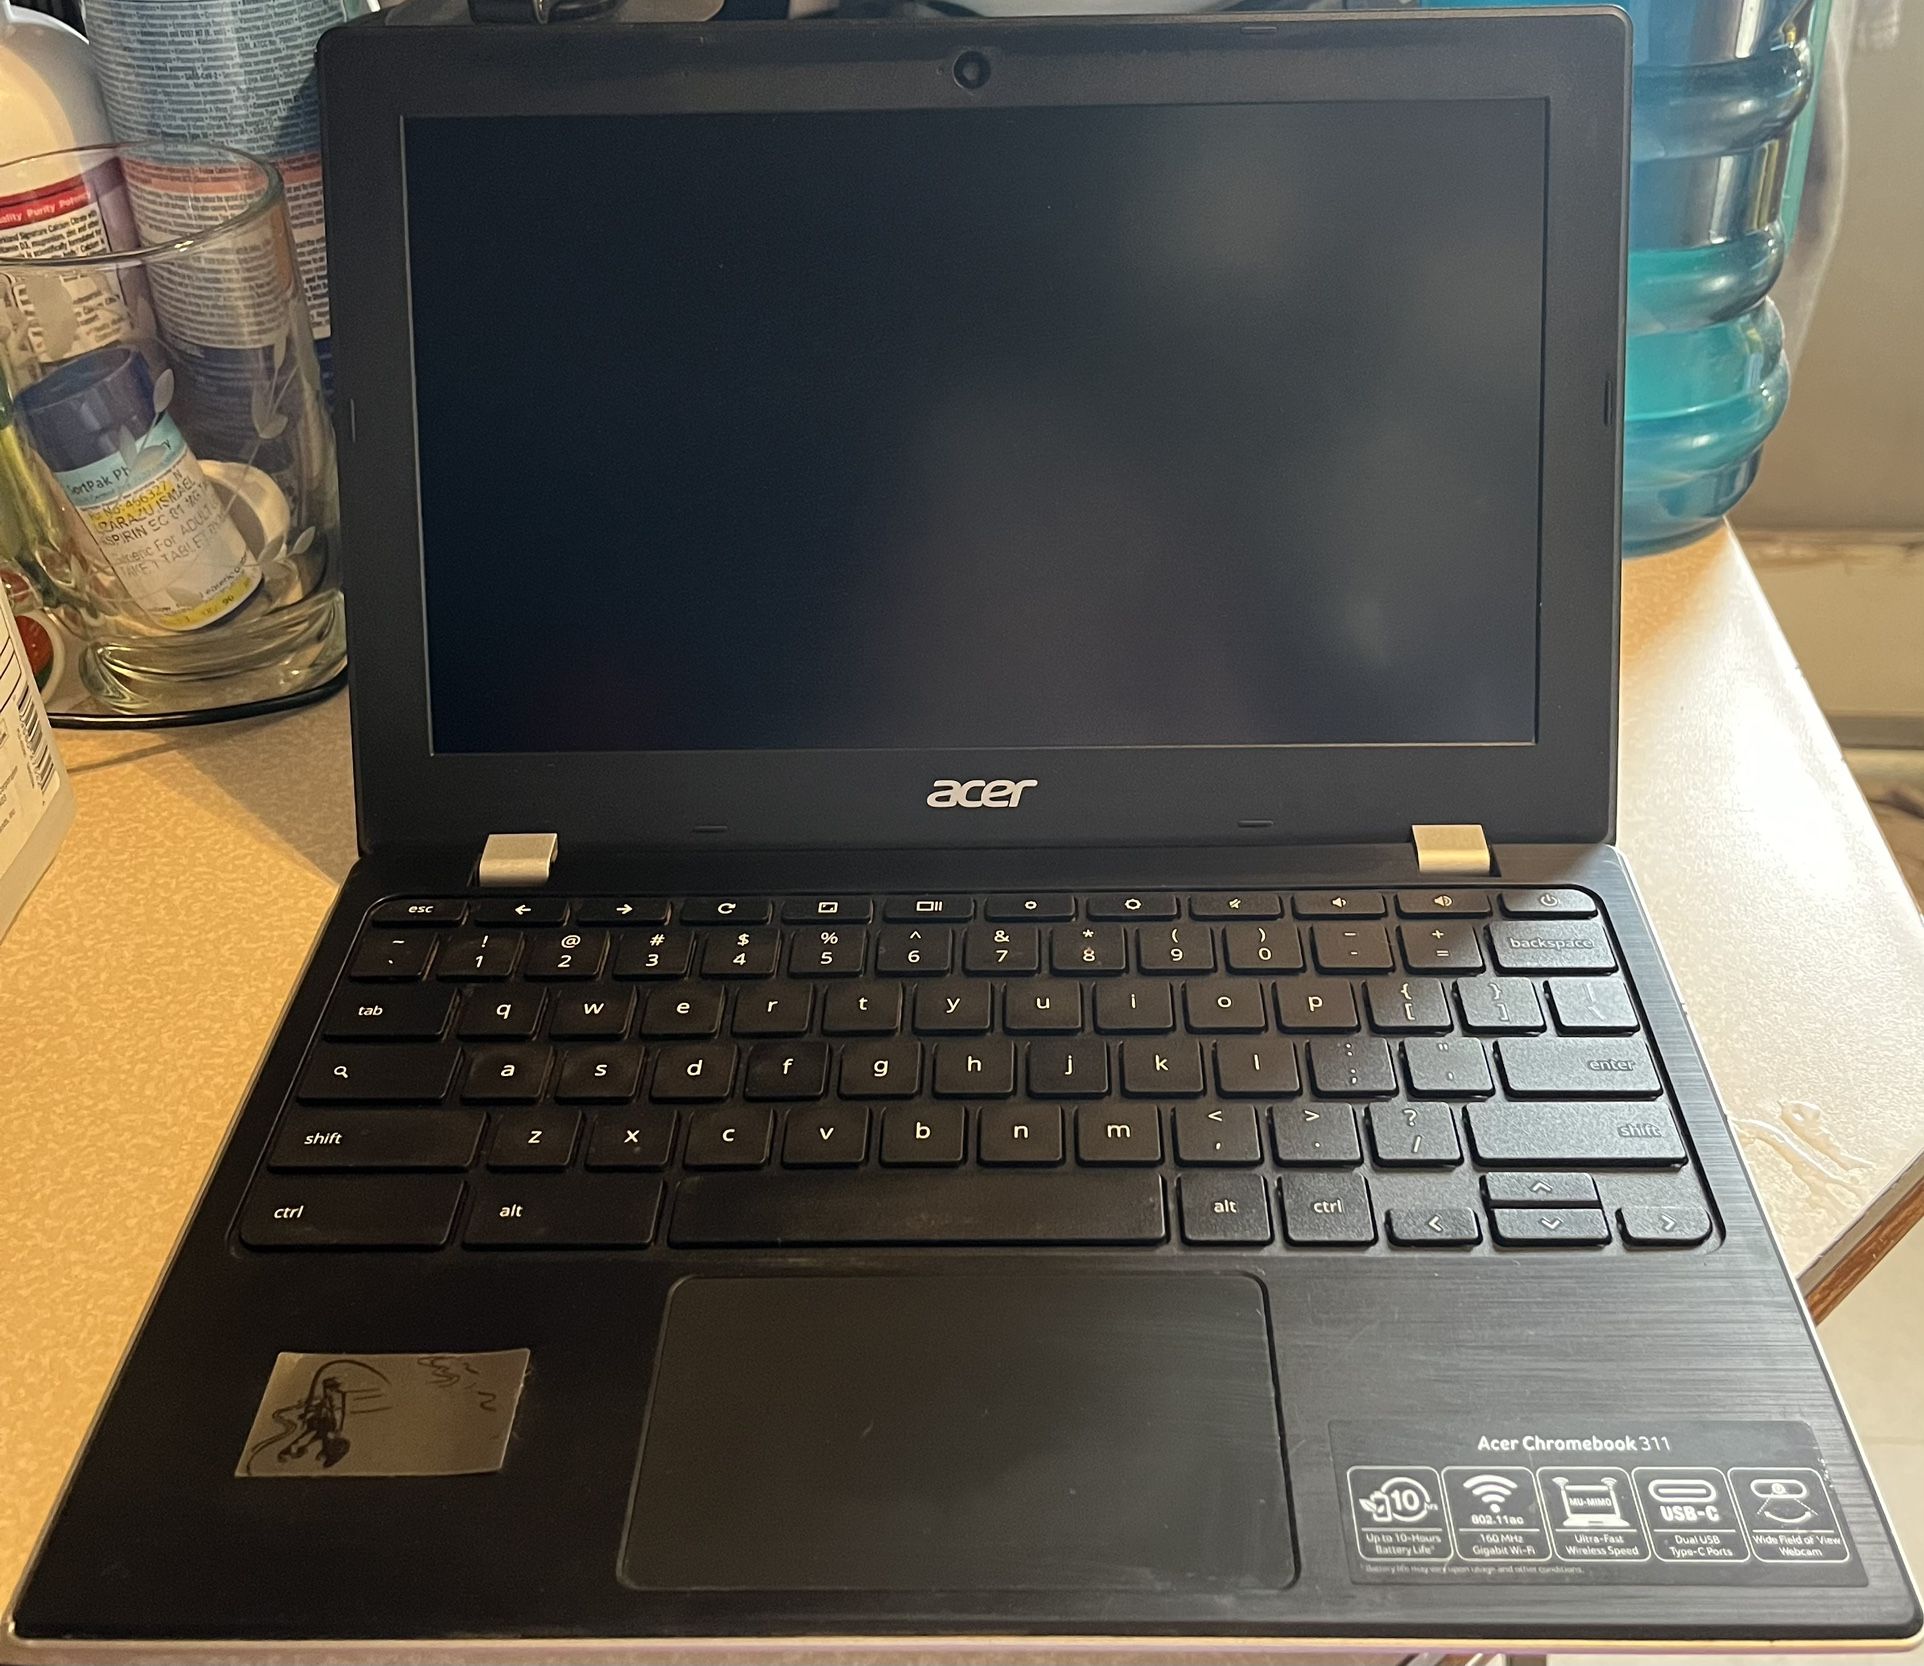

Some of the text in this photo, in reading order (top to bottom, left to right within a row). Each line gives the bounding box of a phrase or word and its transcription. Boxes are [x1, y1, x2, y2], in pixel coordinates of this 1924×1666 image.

[26, 204, 56, 217] Purity
[926, 779, 1038, 808] acer
[408, 905, 434, 913] esc
[649, 933, 665, 946] #
[737, 933, 750, 947] $
[820, 932, 839, 945] %
[994, 930, 1010, 943] &
[1171, 928, 1179, 943] (
[1258, 927, 1266, 943] )
[1432, 929, 1444, 939] +
[481, 935, 489, 948] !
[561, 934, 581, 949] @
[1510, 937, 1594, 951] backspace
[557, 954, 572, 968] 2
[645, 953, 659, 967] 3
[732, 952, 747, 966] 4
[820, 951, 833, 965] 5
[907, 950, 920, 963] 6
[995, 949, 1009, 963] 7
[1082, 947, 1096, 962] 8
[1170, 948, 1183, 962] 9
[1258, 947, 1272, 961] 0
[475, 955, 484, 968] 1
[1400, 983, 1412, 1000] {
[1490, 983, 1501, 1000] }
[676, 1002, 690, 1014] e
[767, 1000, 779, 1013] r
[859, 997, 868, 1011] t
[946, 998, 961, 1014] y
[1036, 997, 1050, 1009] u
[1131, 993, 1136, 1009] i
[1217, 996, 1232, 1008] o
[1308, 996, 1323, 1012] p
[358, 1005, 383, 1016] tab
[496, 1004, 512, 1020] q
[584, 1002, 605, 1015] w
[1404, 1003, 1416, 1020] [
[1498, 1003, 1510, 1021] ]
[686, 1059, 703, 1076] d
[782, 1058, 794, 1075] f
[873, 1060, 889, 1077] g
[967, 1055, 982, 1072] h
[1064, 1055, 1073, 1075] j
[1155, 1054, 1169, 1071] k
[1254, 1054, 1260, 1071] l
[1589, 1058, 1635, 1071] enter
[500, 1064, 515, 1077] a
[594, 1064, 608, 1077] s
[1208, 1110, 1223, 1122] <
[1304, 1110, 1320, 1122] >
[1404, 1109, 1416, 1126] ?
[528, 1130, 543, 1144] z
[624, 1129, 640, 1143] x
[722, 1128, 736, 1142] c
[819, 1127, 834, 1140] v
[915, 1121, 931, 1139] b
[1013, 1125, 1029, 1139] n
[1107, 1124, 1131, 1138] m
[1618, 1123, 1662, 1138] shift
[304, 1132, 342, 1145] shift
[1413, 1136, 1421, 1153] /
[273, 1205, 304, 1219] ctrl
[499, 1204, 523, 1218] alt
[1214, 1199, 1237, 1213] alt
[1313, 1199, 1343, 1213] ctrl
[1477, 1435, 1672, 1451] Acer Chromebook 311
[1391, 1489, 1420, 1511] 10
[1569, 1497, 1612, 1507] MU-MIMO
[1471, 1515, 1525, 1525] 802.11ac
[1660, 1505, 1720, 1522] USB-C
[1366, 1534, 1441, 1545] Up to 10-Hours
[1480, 1534, 1524, 1543] 160 MHz
[1574, 1534, 1624, 1544] Ultra-Fast
[1675, 1535, 1721, 1545] Dual USB
[1752, 1535, 1841, 1545] Wide Field of View
[1375, 1545, 1411, 1556] Battery
[1472, 1545, 1536, 1557] Gigabit Wi-Fi
[1565, 1546, 1639, 1557] Wireless Speed
[1669, 1547, 1733, 1557] Type-C Ports
[1779, 1547, 1823, 1557] Webcam
